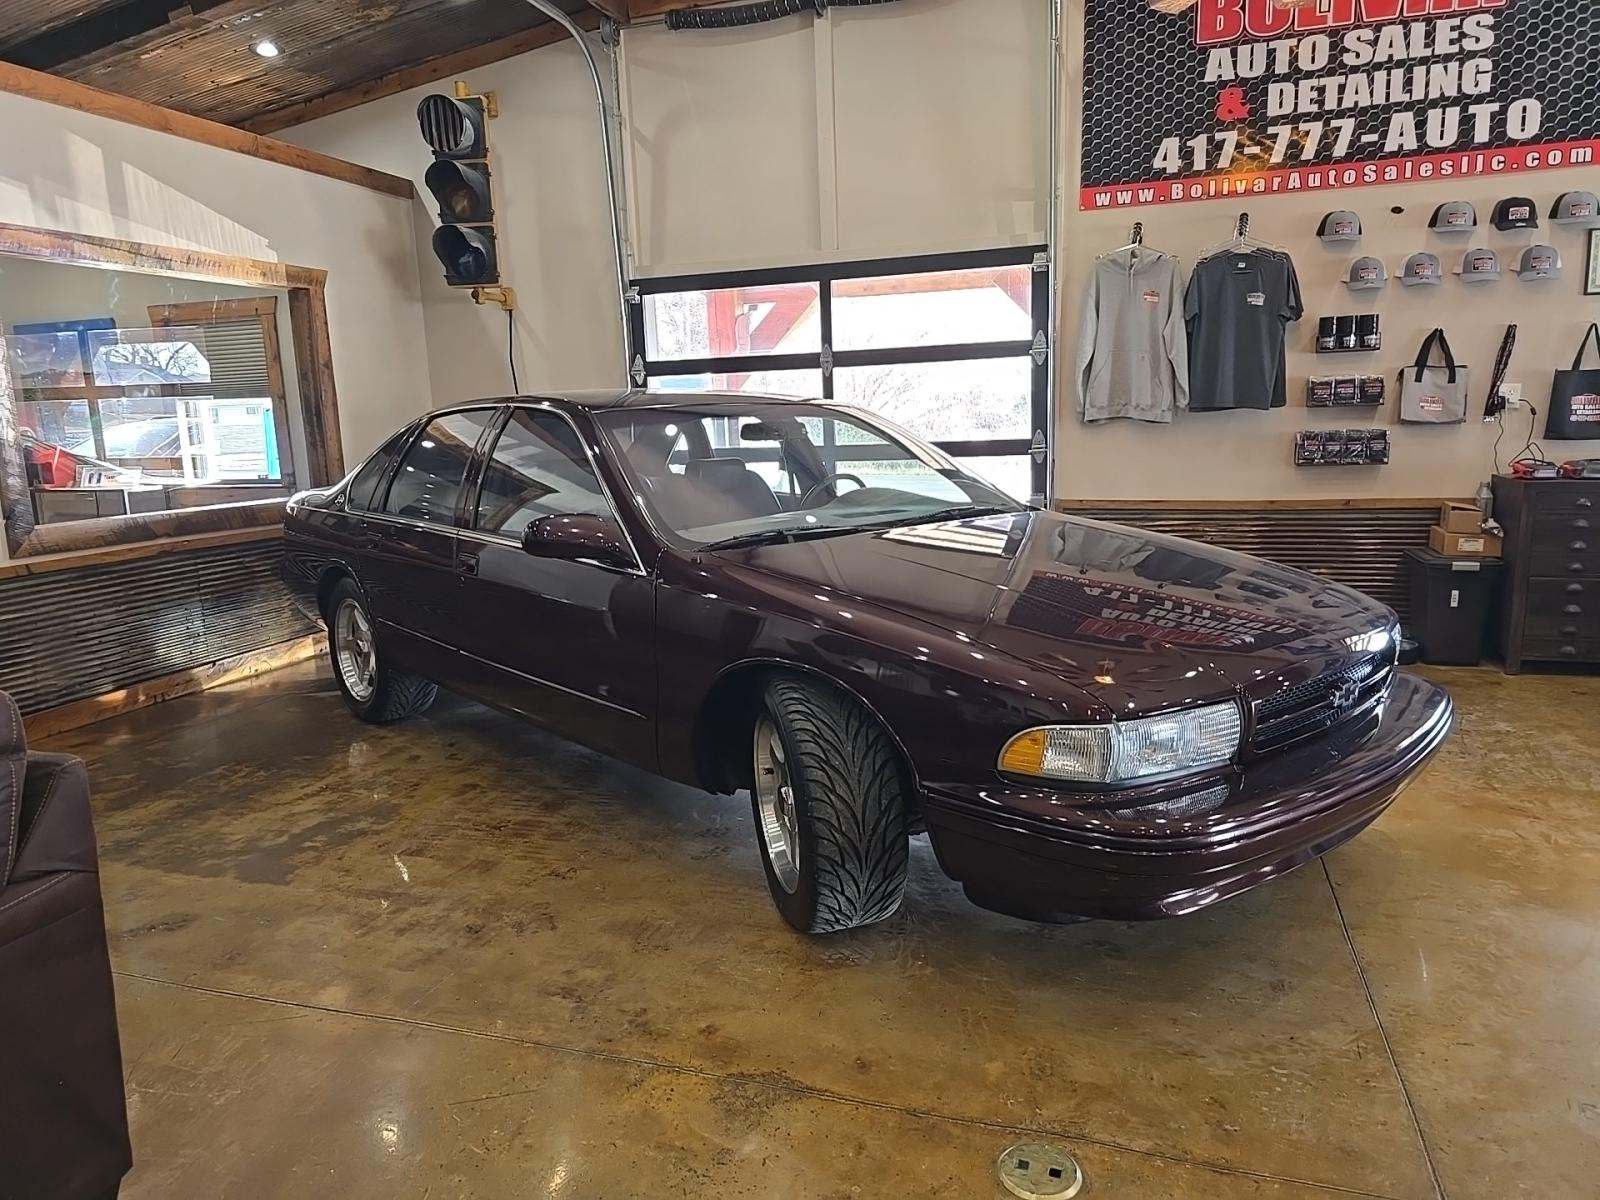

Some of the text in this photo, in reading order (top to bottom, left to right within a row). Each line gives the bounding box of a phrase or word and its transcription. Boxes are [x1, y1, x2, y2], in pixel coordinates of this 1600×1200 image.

[1204, 35, 1330, 83] AUTO
[1342, 13, 1495, 66] SALES
[1215, 57, 1493, 122] & DETAILING
[1152, 98, 1542, 174] 417-777-AUTO
[1094, 146, 1593, 207] www.BolivarAutoSalesllc.com
